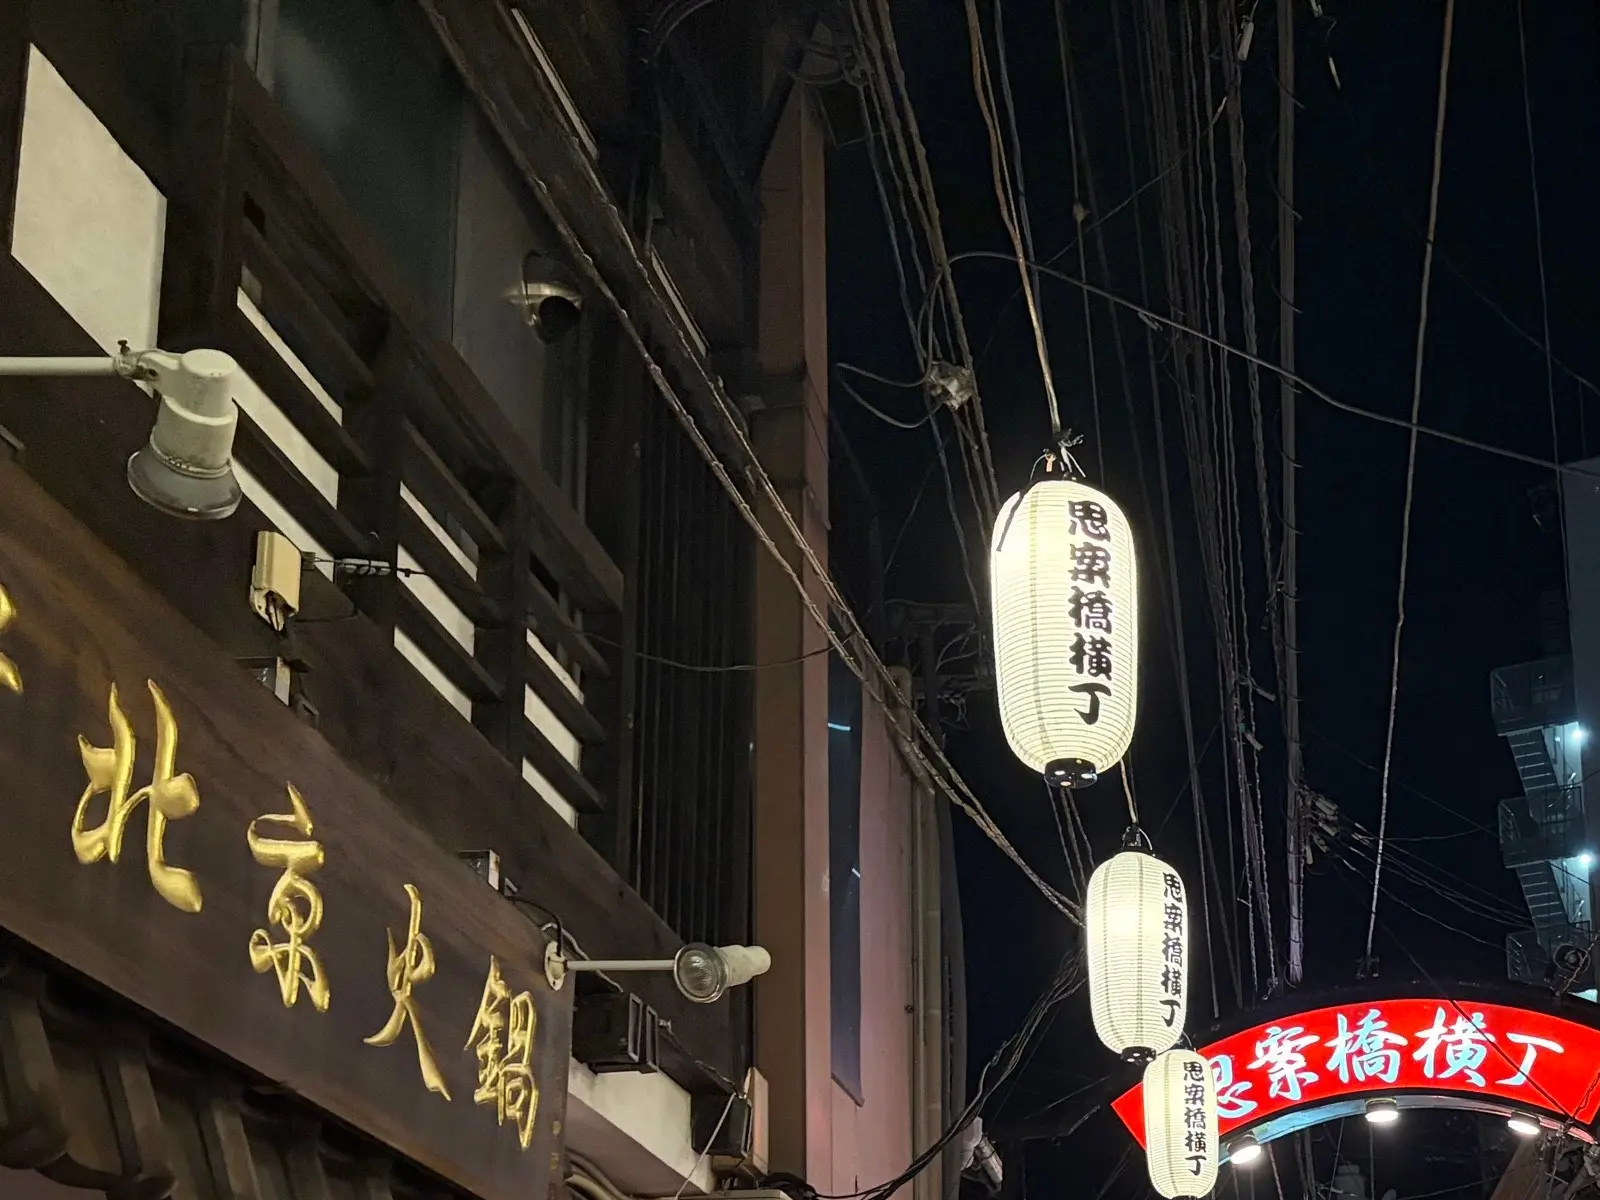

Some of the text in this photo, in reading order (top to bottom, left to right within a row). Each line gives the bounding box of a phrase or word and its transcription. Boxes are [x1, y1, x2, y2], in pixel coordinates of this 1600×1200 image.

[1067, 498, 1113, 727] 思案橋横丁
[0, 583, 541, 1151] 北京火鍋
[1161, 870, 1187, 1028] 思案橋横丁
[1182, 1058, 1209, 1178] 思案橋横丁
